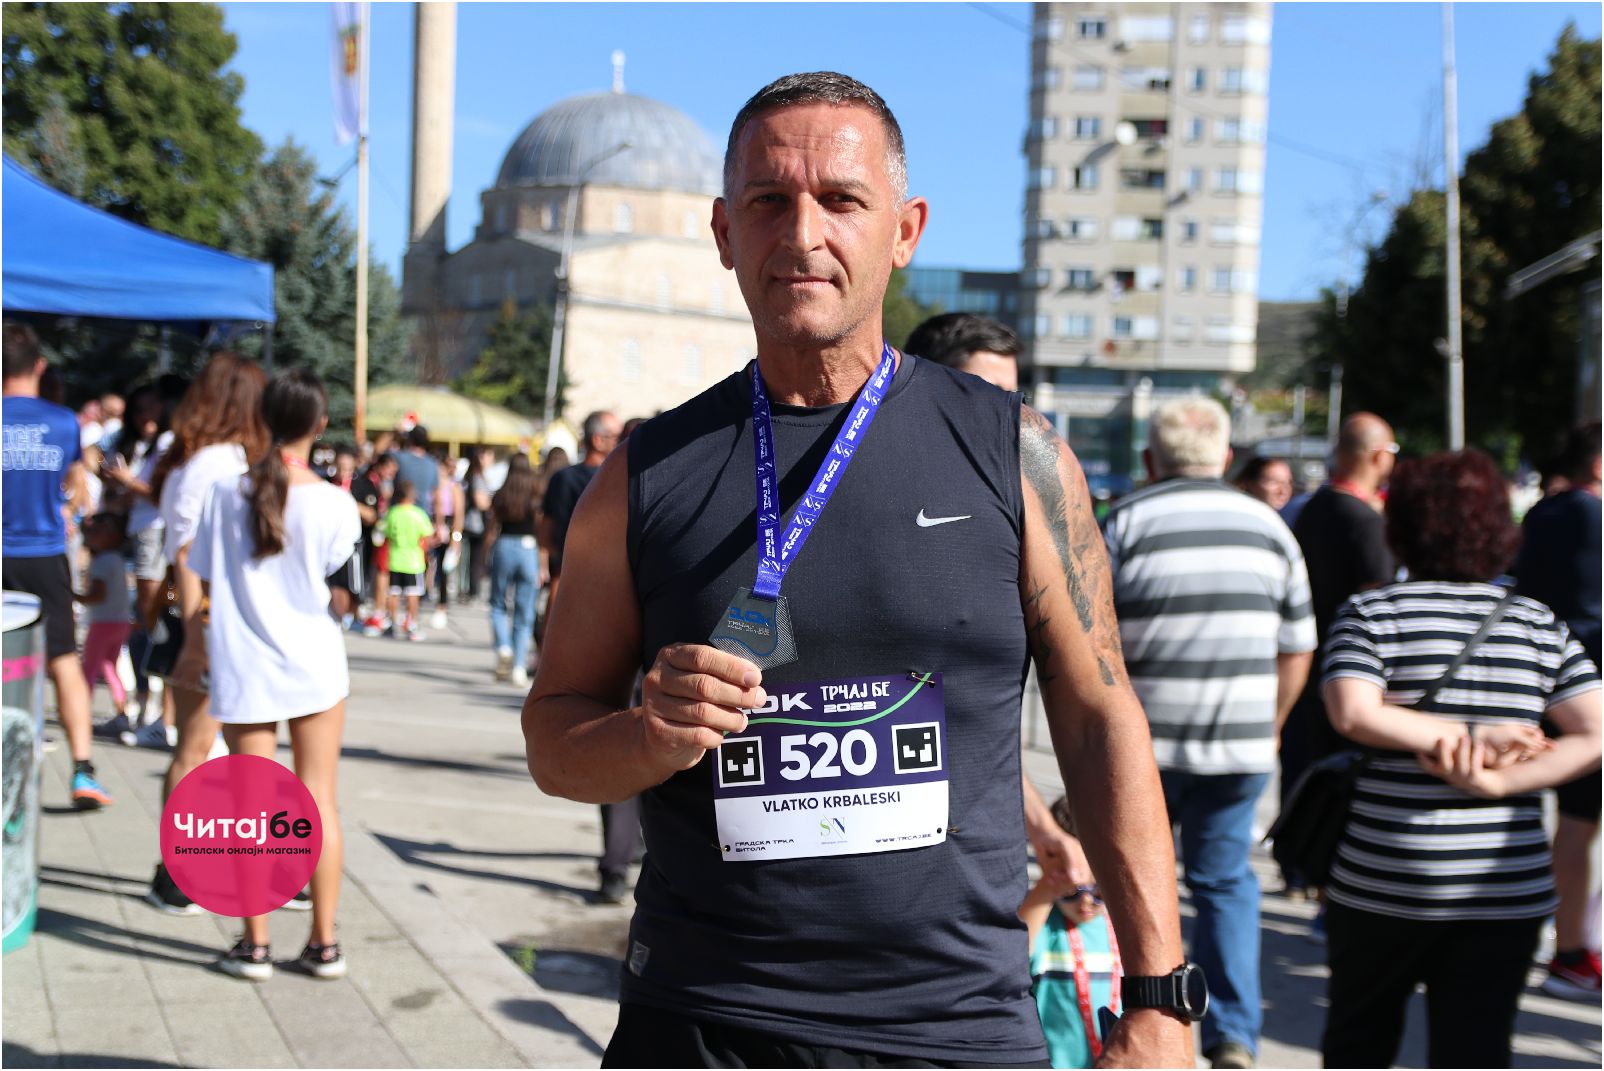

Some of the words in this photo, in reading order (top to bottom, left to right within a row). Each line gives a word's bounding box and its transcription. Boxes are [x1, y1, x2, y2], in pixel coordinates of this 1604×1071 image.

[820, 683, 868, 701] ТРЧАЈ
[871, 681, 890, 697] БЕ
[737, 692, 813, 714] 0K
[823, 701, 877, 713] 2022
[780, 729, 877, 781] 520
[763, 797, 819, 813] VLATKO
[823, 791, 901, 810] KRBALESKI
